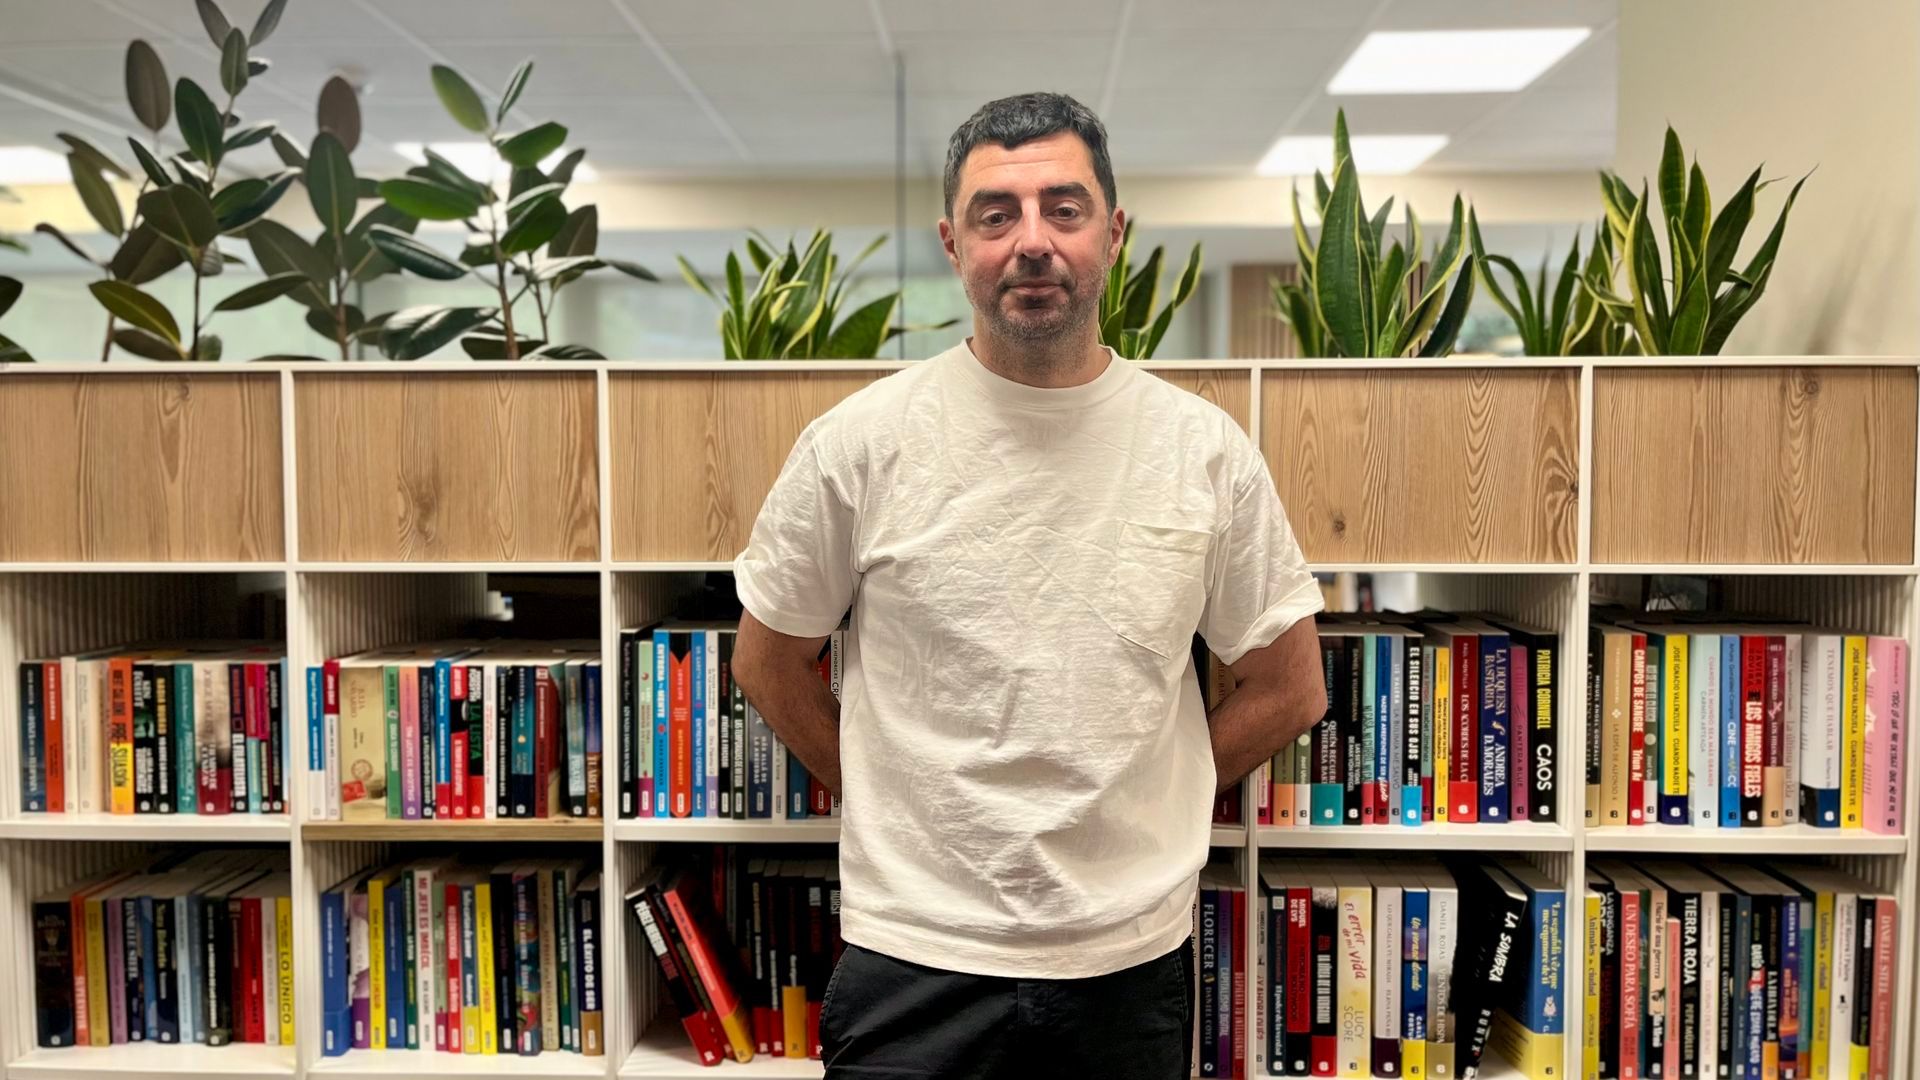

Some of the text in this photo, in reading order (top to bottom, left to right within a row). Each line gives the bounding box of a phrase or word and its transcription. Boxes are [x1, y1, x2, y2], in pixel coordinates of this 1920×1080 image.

[1673, 646, 1681, 662] JOSÉ
[1484, 655, 1495, 709] BASTARDA
[1494, 649, 1506, 715] LA DUQUESA
[1536, 649, 1551, 730] PATRICIA CORNWELL
[1633, 649, 1645, 732] CAMPOS DE SANGRE
[1825, 648, 1835, 751] TENEMOS QUE HABLAR
[1393, 708, 1399, 719] LA
[1408, 647, 1419, 760] EL SILENCIO EN SUS OJOS
[1321, 729, 1329, 764] THERESA
[1328, 721, 1338, 747] QUIÉN
[1460, 694, 1469, 774] LOS ACORDES DE LA
[1612, 734, 1621, 751] ESPÍA
[1613, 723, 1619, 732] LA
[1727, 722, 1736, 745] CINE
[696, 748, 702, 756] TU
[1393, 752, 1399, 765] ME
[1483, 735, 1494, 796] D. MORALES
[1494, 743, 1505, 787] ANDREA
[1536, 744, 1552, 791] CAOS
[1672, 738, 1680, 766] CUANDO
[1744, 702, 1762, 798] LOS AMIGOS FIELES
[1672, 767, 1680, 786] NADIE
[420, 877, 431, 970] MI JEFE ES IMBÉCIL
[1290, 899, 1298, 909] DE
[1298, 899, 1306, 928] MIGUEL
[1344, 903, 1365, 945] El error
[1605, 892, 1614, 955] LA VENGANZA
[1655, 902, 1663, 924] Diario
[1204, 904, 1214, 969] FLORECER
[1342, 928, 1351, 938] de
[1349, 951, 1367, 980] vida
[1411, 932, 1420, 960] verano
[1488, 912, 1519, 982] LA SOMBRA
[1588, 915, 1597, 996] Animales ciudad
[1683, 898, 1697, 984] TIERRA ROJA
[583, 929, 595, 1010] EL ÉXITO DE SER
[1411, 962, 1421, 991] dorado
[1624, 904, 1638, 1029] UN DESEO PARA SOFÍA
[280, 952, 292, 1024] LO ÚNICO
[1204, 987, 1212, 1017] DANIEL
[1219, 967, 1229, 1037] CAPITALISMO DIGITAL
[1274, 993, 1283, 1013] poder
[1275, 985, 1283, 994] El
[1275, 1014, 1283, 1022] de
[1343, 1006, 1353, 1043] SCORE
[1354, 1010, 1364, 1039] LUCY
[1472, 1009, 1491, 1052] RUNYX
[1684, 1004, 1695, 1061] PEPE MÜLLER
[1275, 1030, 1283, 1056] verdad
